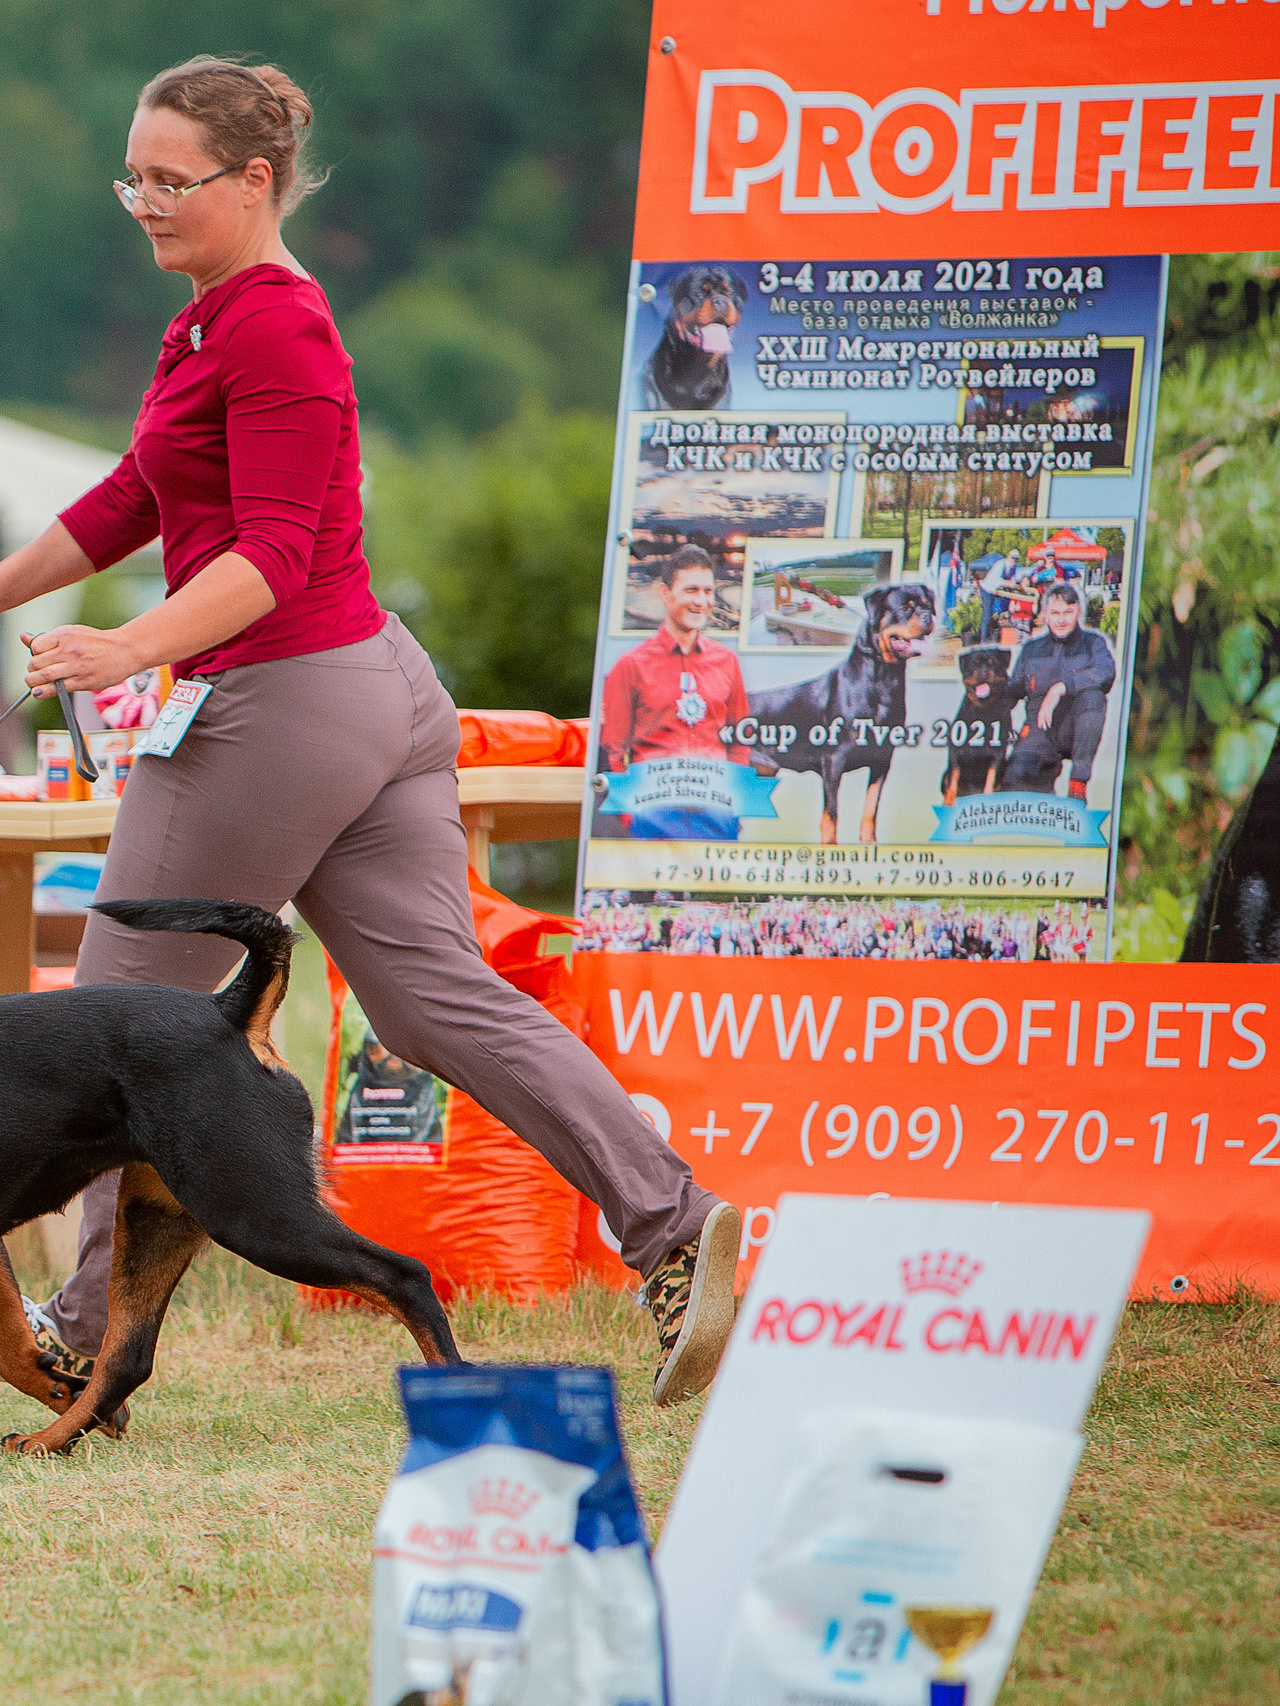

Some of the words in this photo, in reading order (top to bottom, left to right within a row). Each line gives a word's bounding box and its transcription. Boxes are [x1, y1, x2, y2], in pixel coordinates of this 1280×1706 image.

[758, 262, 815, 293] 3-4
[825, 269, 923, 293] июля
[933, 260, 1011, 292] 2021
[1025, 266, 1104, 294] года
[769, 296, 835, 315] Место
[843, 297, 970, 316] проведения
[979, 297, 1078, 313] выставок
[802, 312, 849, 331] база
[857, 314, 931, 332] отдыха
[939, 309, 1060, 330] «Волжанка»
[835, 334, 1100, 366] Межрегиональный
[757, 363, 910, 389] Чемпионат
[918, 363, 1096, 394] Ротвейлеров
[650, 418, 769, 447] Двойная
[776, 423, 977, 450] монопородная
[985, 422, 1113, 443] выставка
[665, 446, 727, 472] КЧК
[734, 452, 754, 472] и
[761, 446, 823, 472] КЧК
[830, 452, 846, 472] с
[853, 445, 959, 472] особым
[967, 451, 1093, 478] статусом
[718, 717, 798, 753] «Cup
[808, 716, 845, 747] of
[852, 717, 922, 747] Tver
[959, 800, 1033, 819] Aleksandar
[609, 988, 1267, 1069] WWW.PROFIPETS
[690, 1102, 774, 1156] +7
[800, 1100, 965, 1170] (909)
[750, 1296, 909, 1355] ROYAL
[922, 1306, 1098, 1363] CANIN
